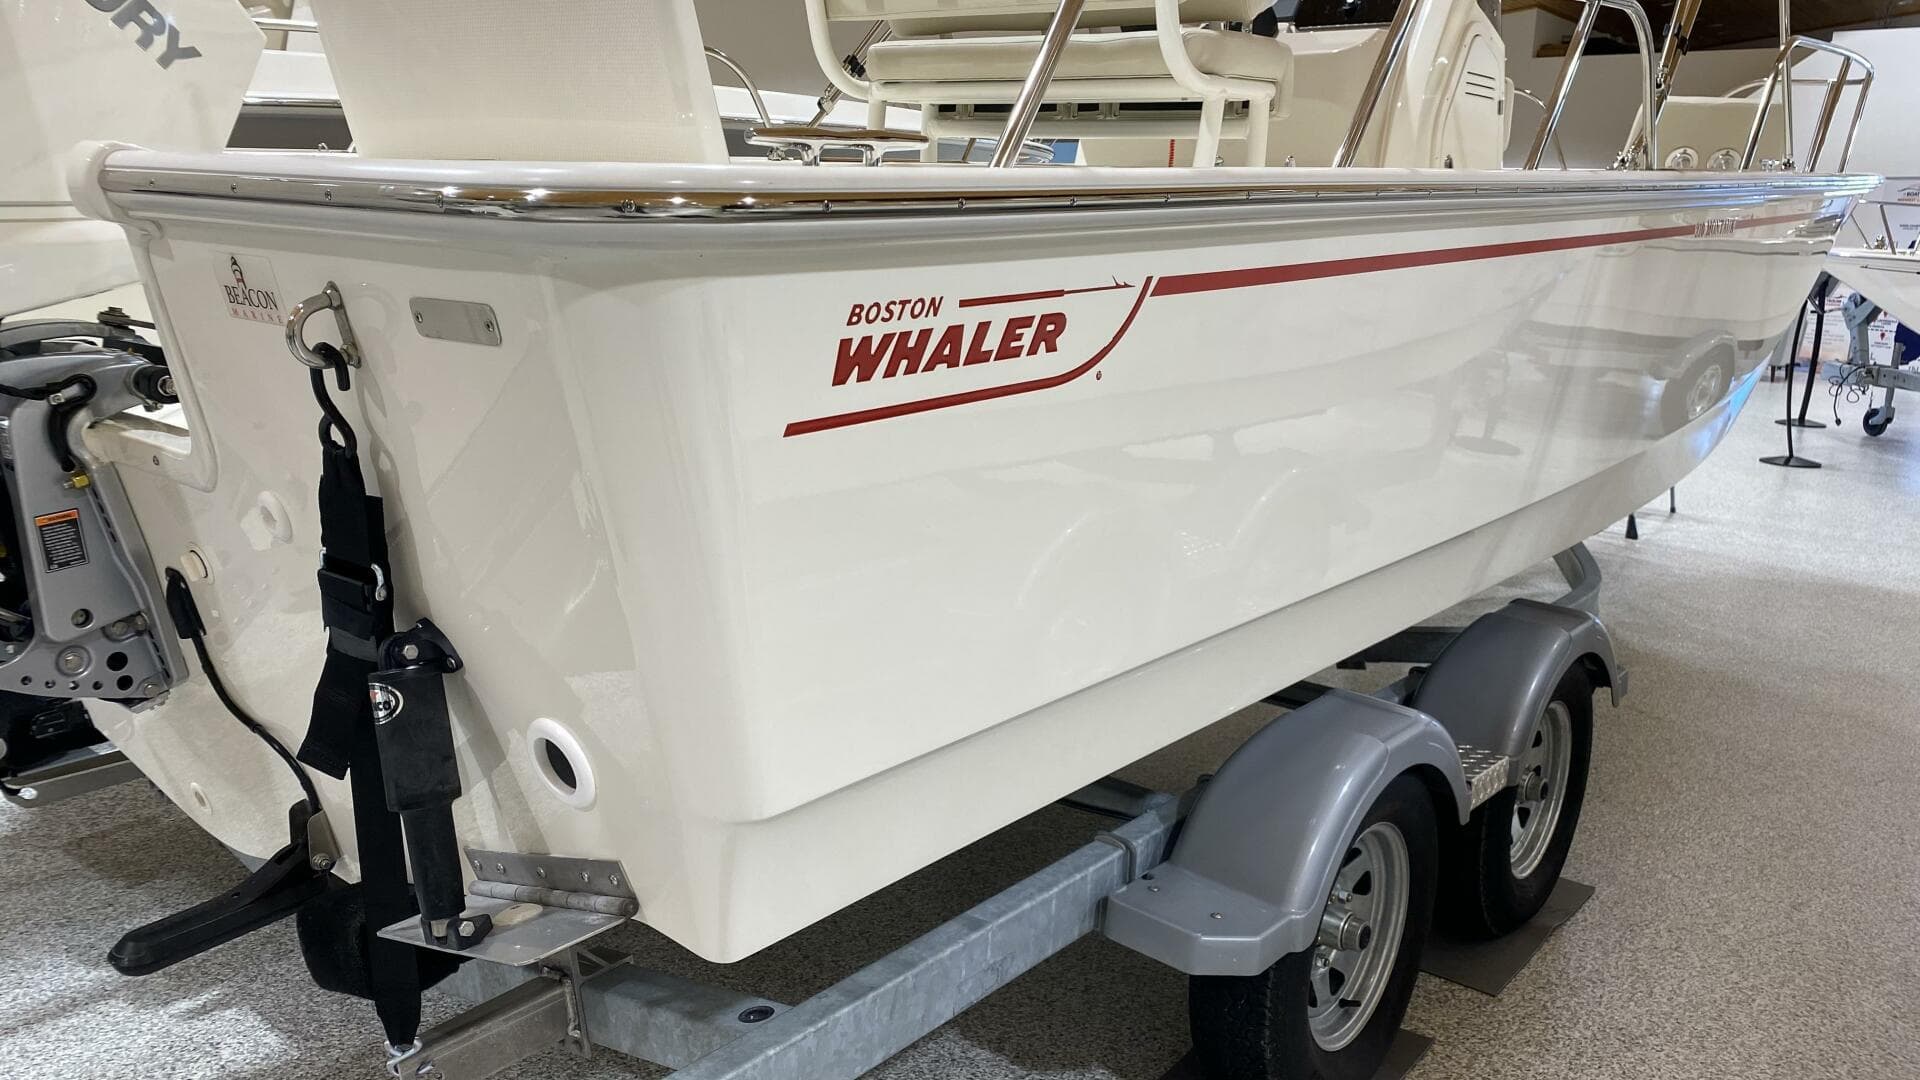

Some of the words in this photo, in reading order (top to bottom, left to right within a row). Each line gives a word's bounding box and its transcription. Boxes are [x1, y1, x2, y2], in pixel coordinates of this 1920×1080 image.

[224, 284, 279, 311] BEACON
[846, 296, 944, 327] BOSTON
[831, 312, 1067, 387] WHALER
